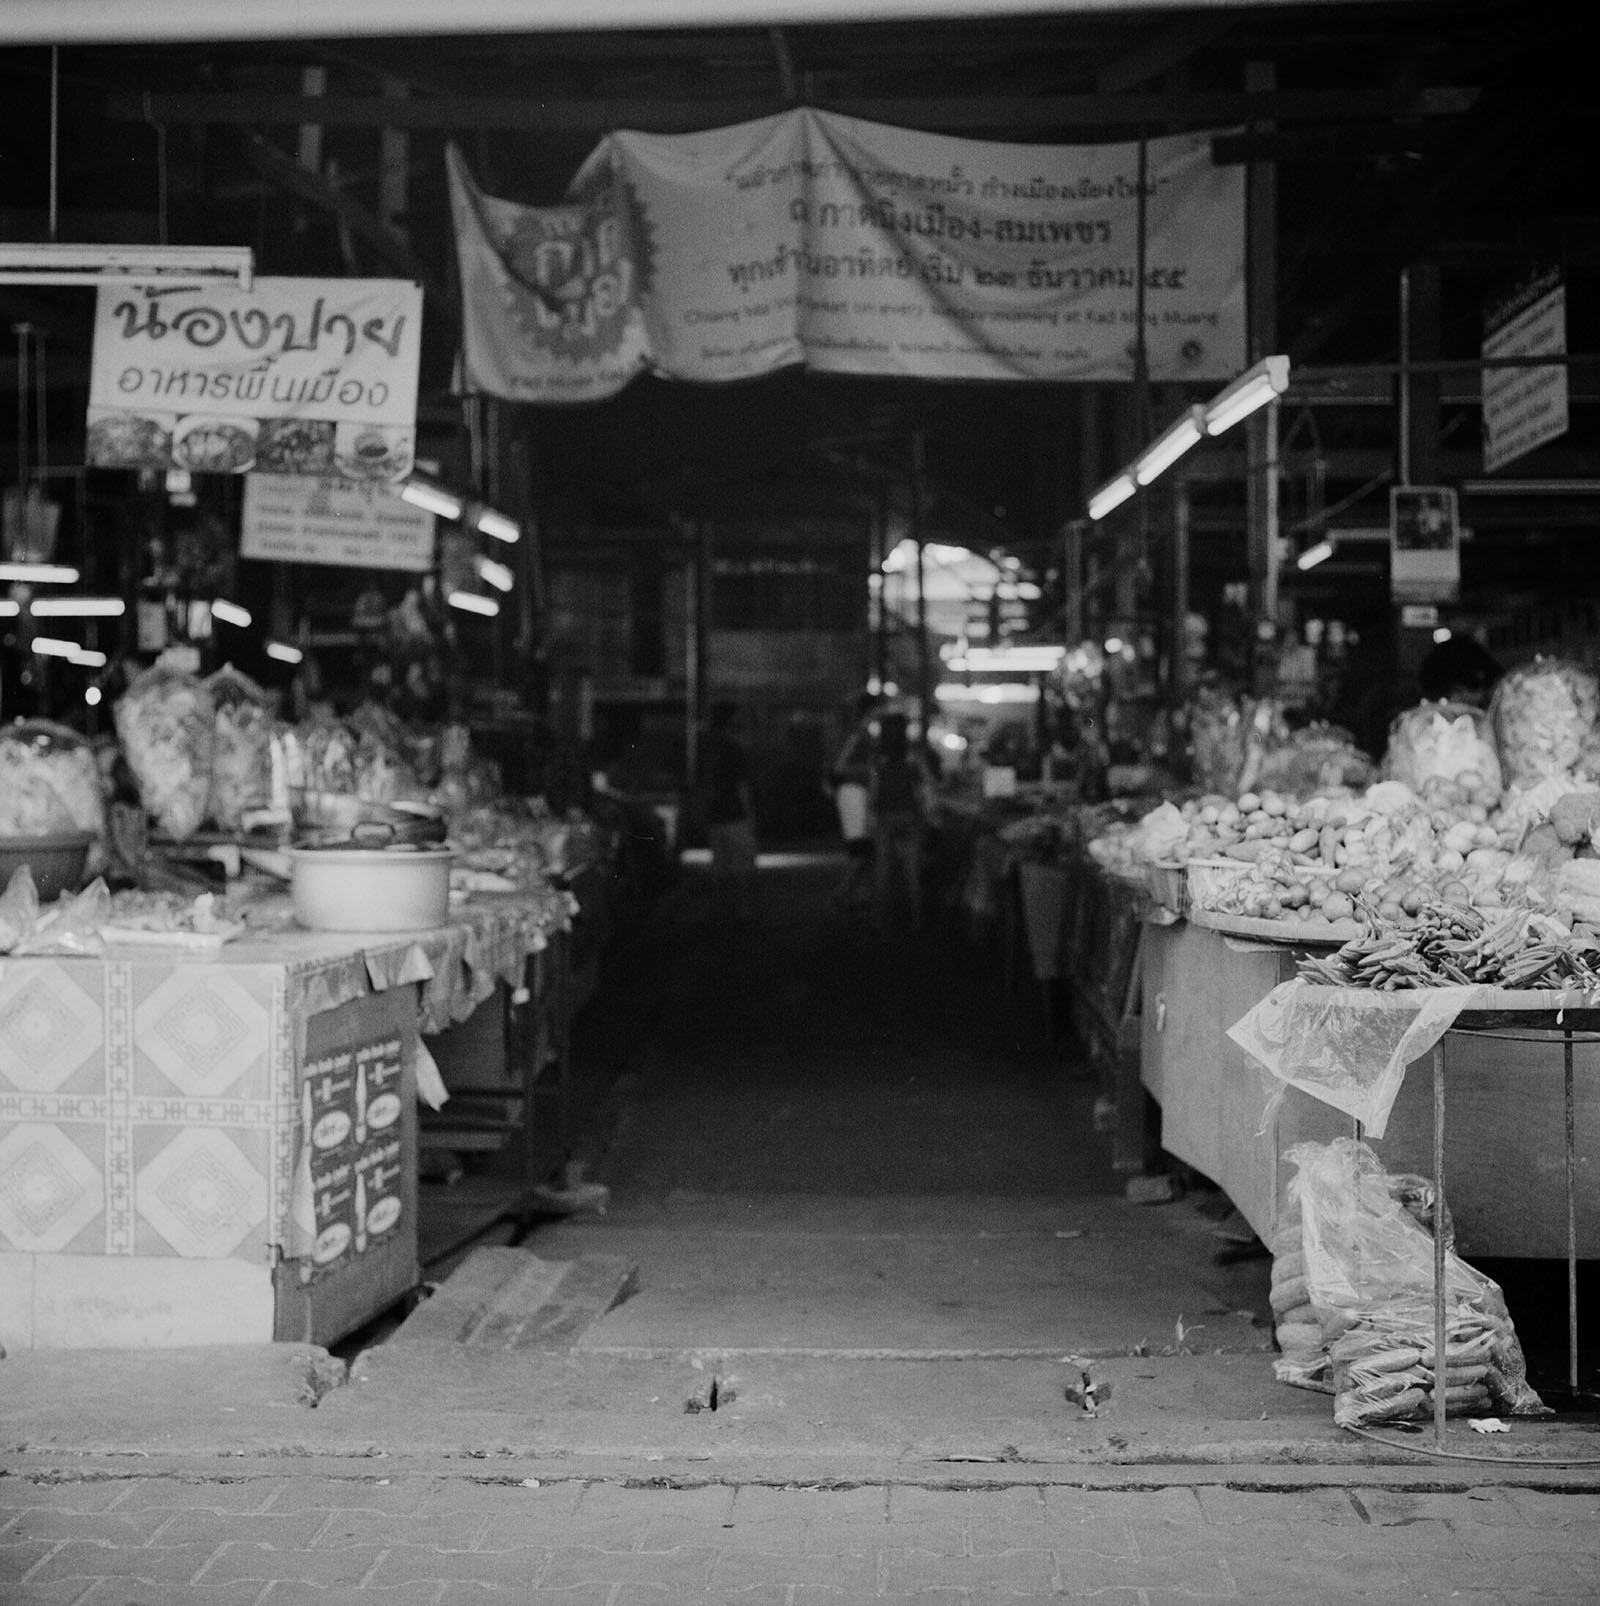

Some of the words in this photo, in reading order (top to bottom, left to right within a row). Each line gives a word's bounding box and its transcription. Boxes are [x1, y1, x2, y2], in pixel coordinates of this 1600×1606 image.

[112, 284, 407, 358] น้องปาย
[117, 356, 390, 407] อาหารพื้นเมือง
